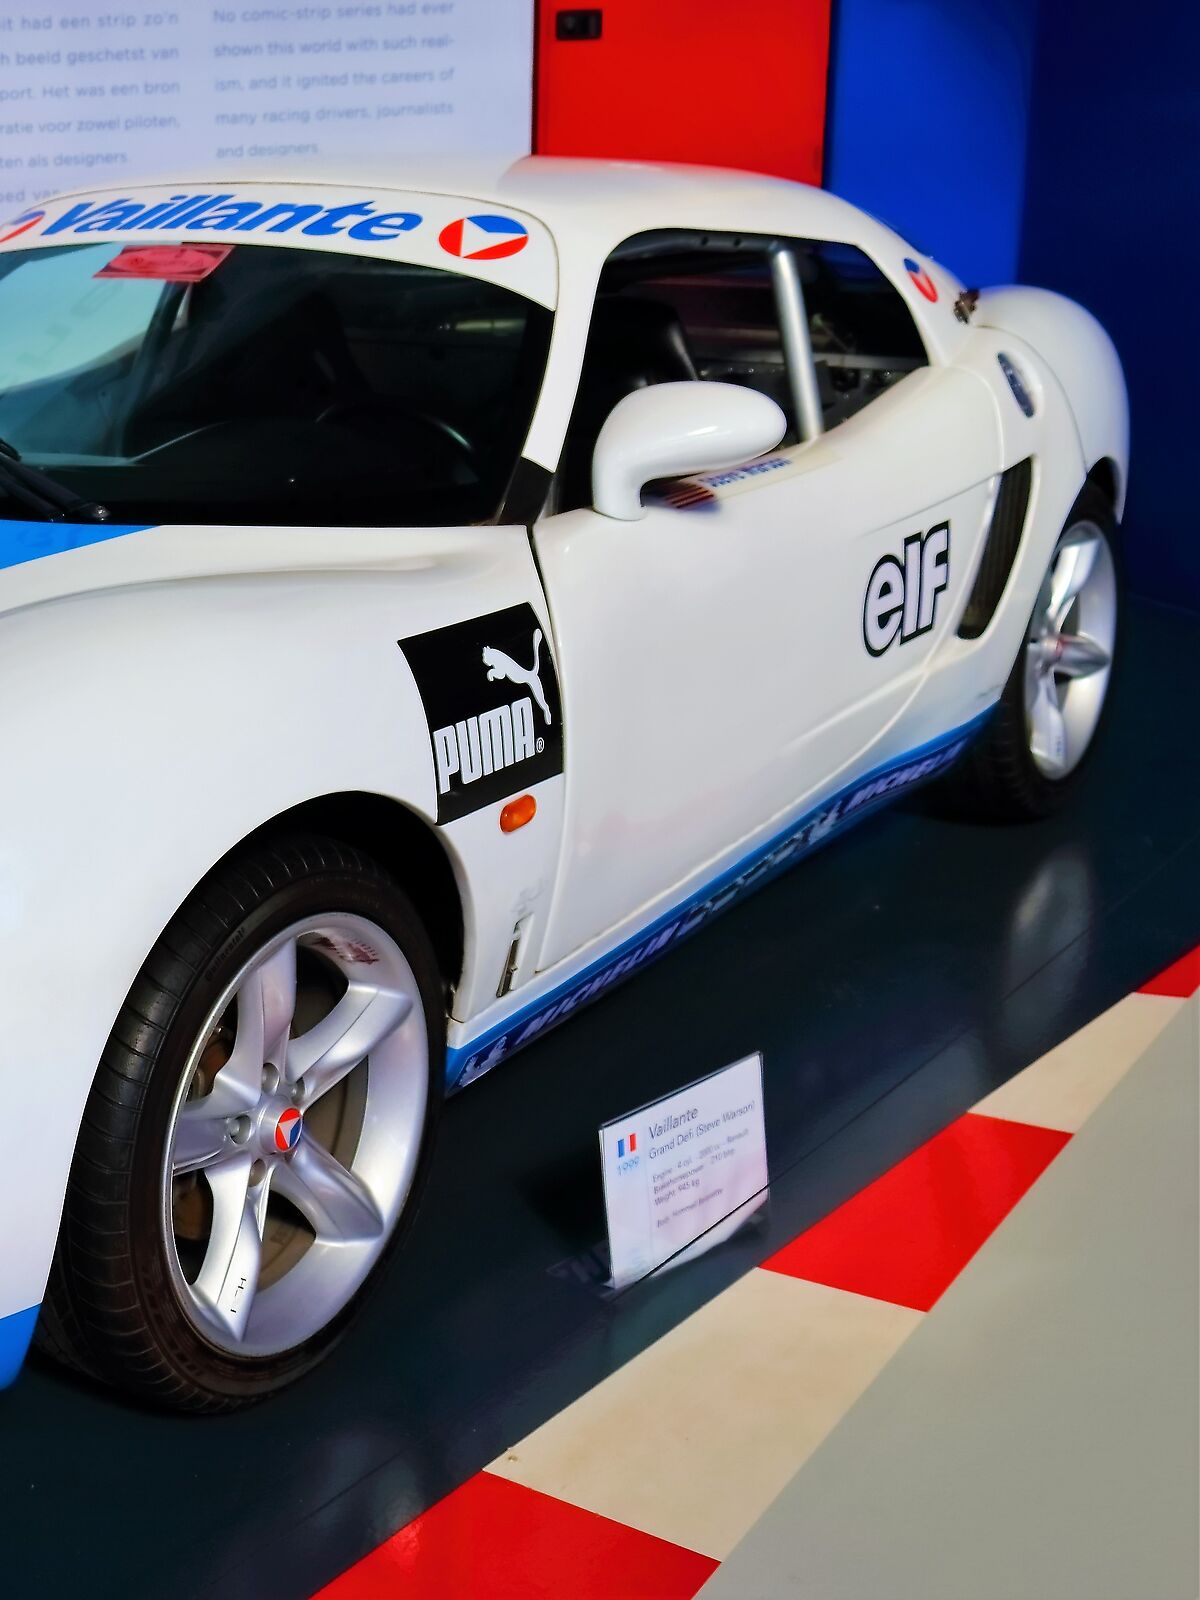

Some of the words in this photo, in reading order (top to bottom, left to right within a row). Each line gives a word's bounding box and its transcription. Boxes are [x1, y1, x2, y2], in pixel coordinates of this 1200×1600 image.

[21, 16, 52, 30] had
[59, 16, 91, 29] een
[97, 13, 136, 29] strip
[213, 10, 236, 23] No
[337, 4, 381, 18] series
[387, 1, 417, 16] had
[422, 3, 454, 15] ever
[16, 50, 61, 65] beeld
[67, 46, 145, 66] geschetst
[151, 47, 179, 60] van
[214, 43, 263, 57] shown
[267, 41, 294, 55] this
[300, 39, 342, 53] world
[346, 37, 378, 51] with
[383, 35, 417, 49] such
[42, 84, 70, 99] Het
[76, 84, 105, 97] was
[110, 82, 140, 96] een
[144, 80, 180, 94] bron
[249, 75, 277, 90] and
[282, 74, 292, 88] it
[297, 72, 348, 90] ignited
[353, 70, 377, 85] the
[382, 70, 435, 85] careers
[440, 67, 455, 81] of
[38, 120, 72, 134] voor
[77, 116, 120, 132] zowel
[215, 111, 256, 126] many
[263, 107, 311, 124] racing
[376, 102, 454, 121] journalists
[28, 153, 49, 168] als
[216, 145, 244, 158] and
[41, 194, 423, 241] Vaillante
[863, 519, 951, 659] elf
[515, 921, 681, 1045] MICHELIN
[649, 1107, 698, 1139] Vaillante
[649, 1139, 675, 1159] Grand
